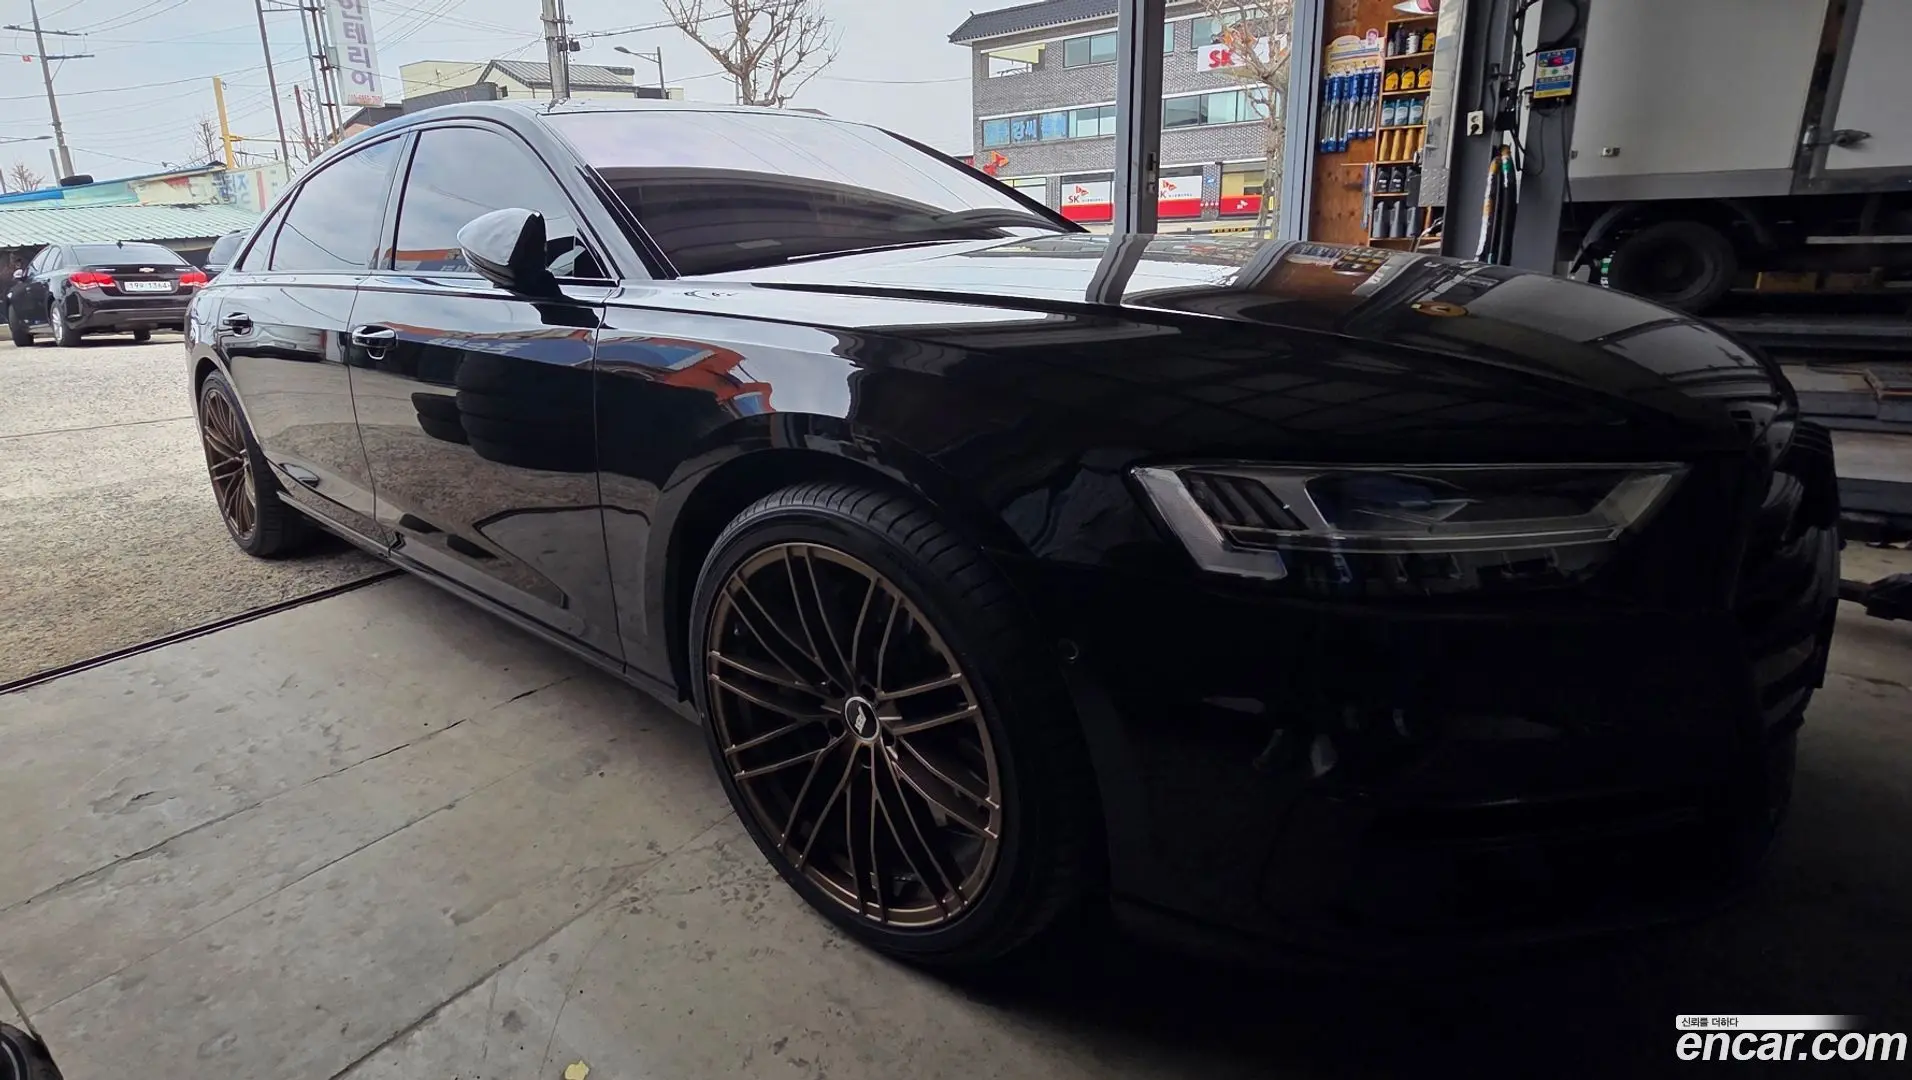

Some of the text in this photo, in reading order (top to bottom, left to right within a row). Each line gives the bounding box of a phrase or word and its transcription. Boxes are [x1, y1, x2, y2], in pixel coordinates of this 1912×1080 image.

[340, 0, 375, 92] 인테리어
[1209, 49, 1235, 68] SK
[1068, 195, 1080, 203] SK
